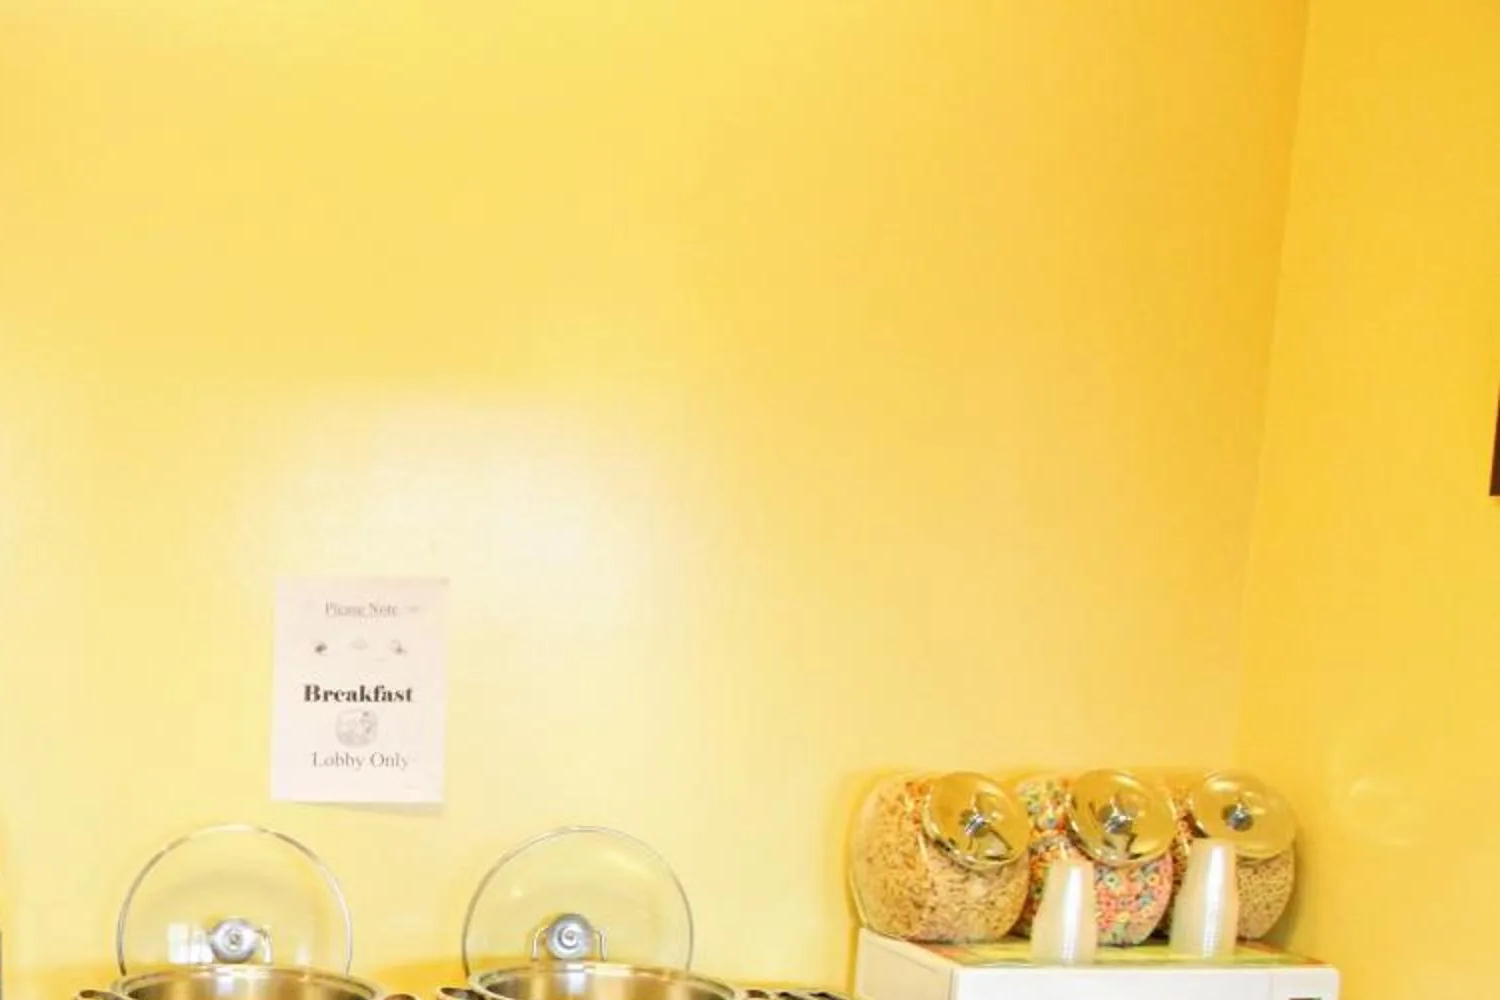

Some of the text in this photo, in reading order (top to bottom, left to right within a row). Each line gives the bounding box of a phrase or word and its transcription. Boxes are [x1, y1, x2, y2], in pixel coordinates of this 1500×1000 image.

[325, 601, 364, 617] Please
[303, 684, 413, 703] Breakfast
[312, 751, 409, 771] Lobby Only
